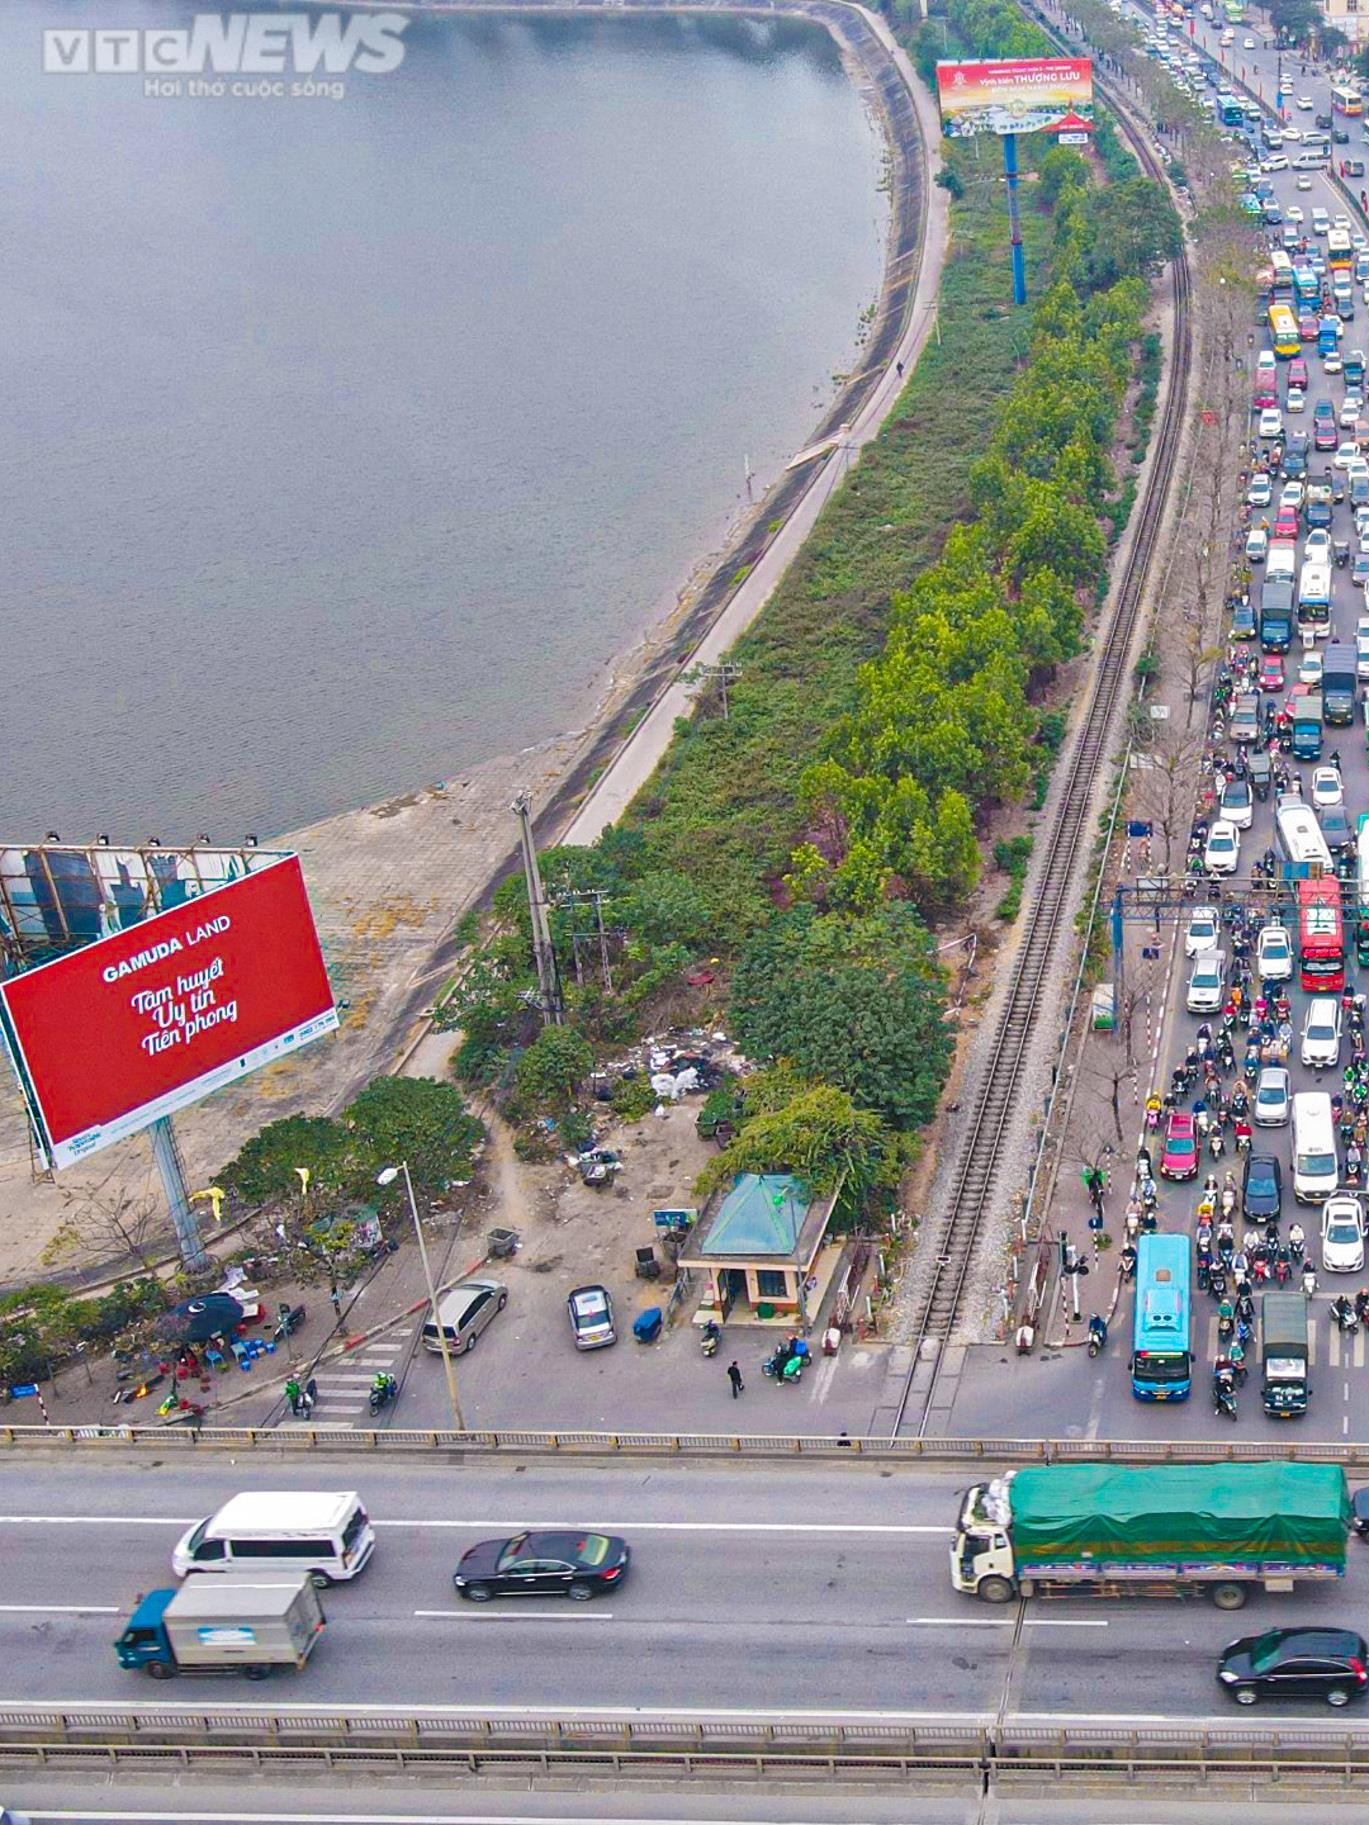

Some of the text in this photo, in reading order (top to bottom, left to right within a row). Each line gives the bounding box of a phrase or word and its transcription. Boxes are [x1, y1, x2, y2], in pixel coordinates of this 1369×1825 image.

[1059, 71, 1080, 82] LƯU
[103, 915, 231, 983] GAMUDA LAND
[131, 956, 224, 1015] Tâm huyết
[152, 988, 216, 1028] Uy tín
[141, 1000, 238, 1056] Tiên phong
